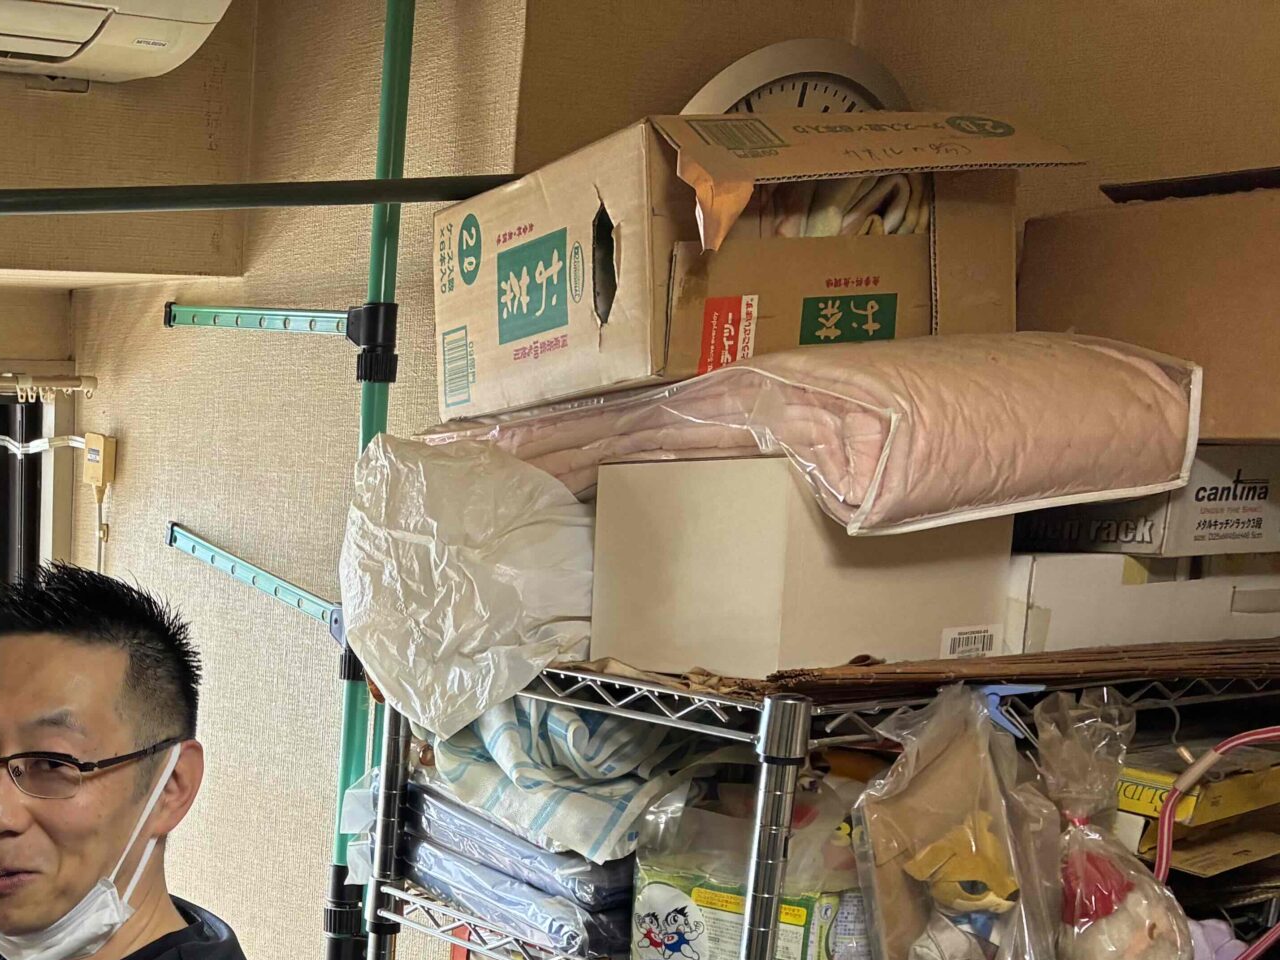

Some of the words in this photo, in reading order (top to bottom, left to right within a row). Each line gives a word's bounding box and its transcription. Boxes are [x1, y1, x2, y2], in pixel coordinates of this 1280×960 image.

[500, 248, 564, 320] お茶
[814, 299, 882, 341] お茶
[1194, 468, 1270, 503] cantina
[1088, 515, 1154, 543] rack
